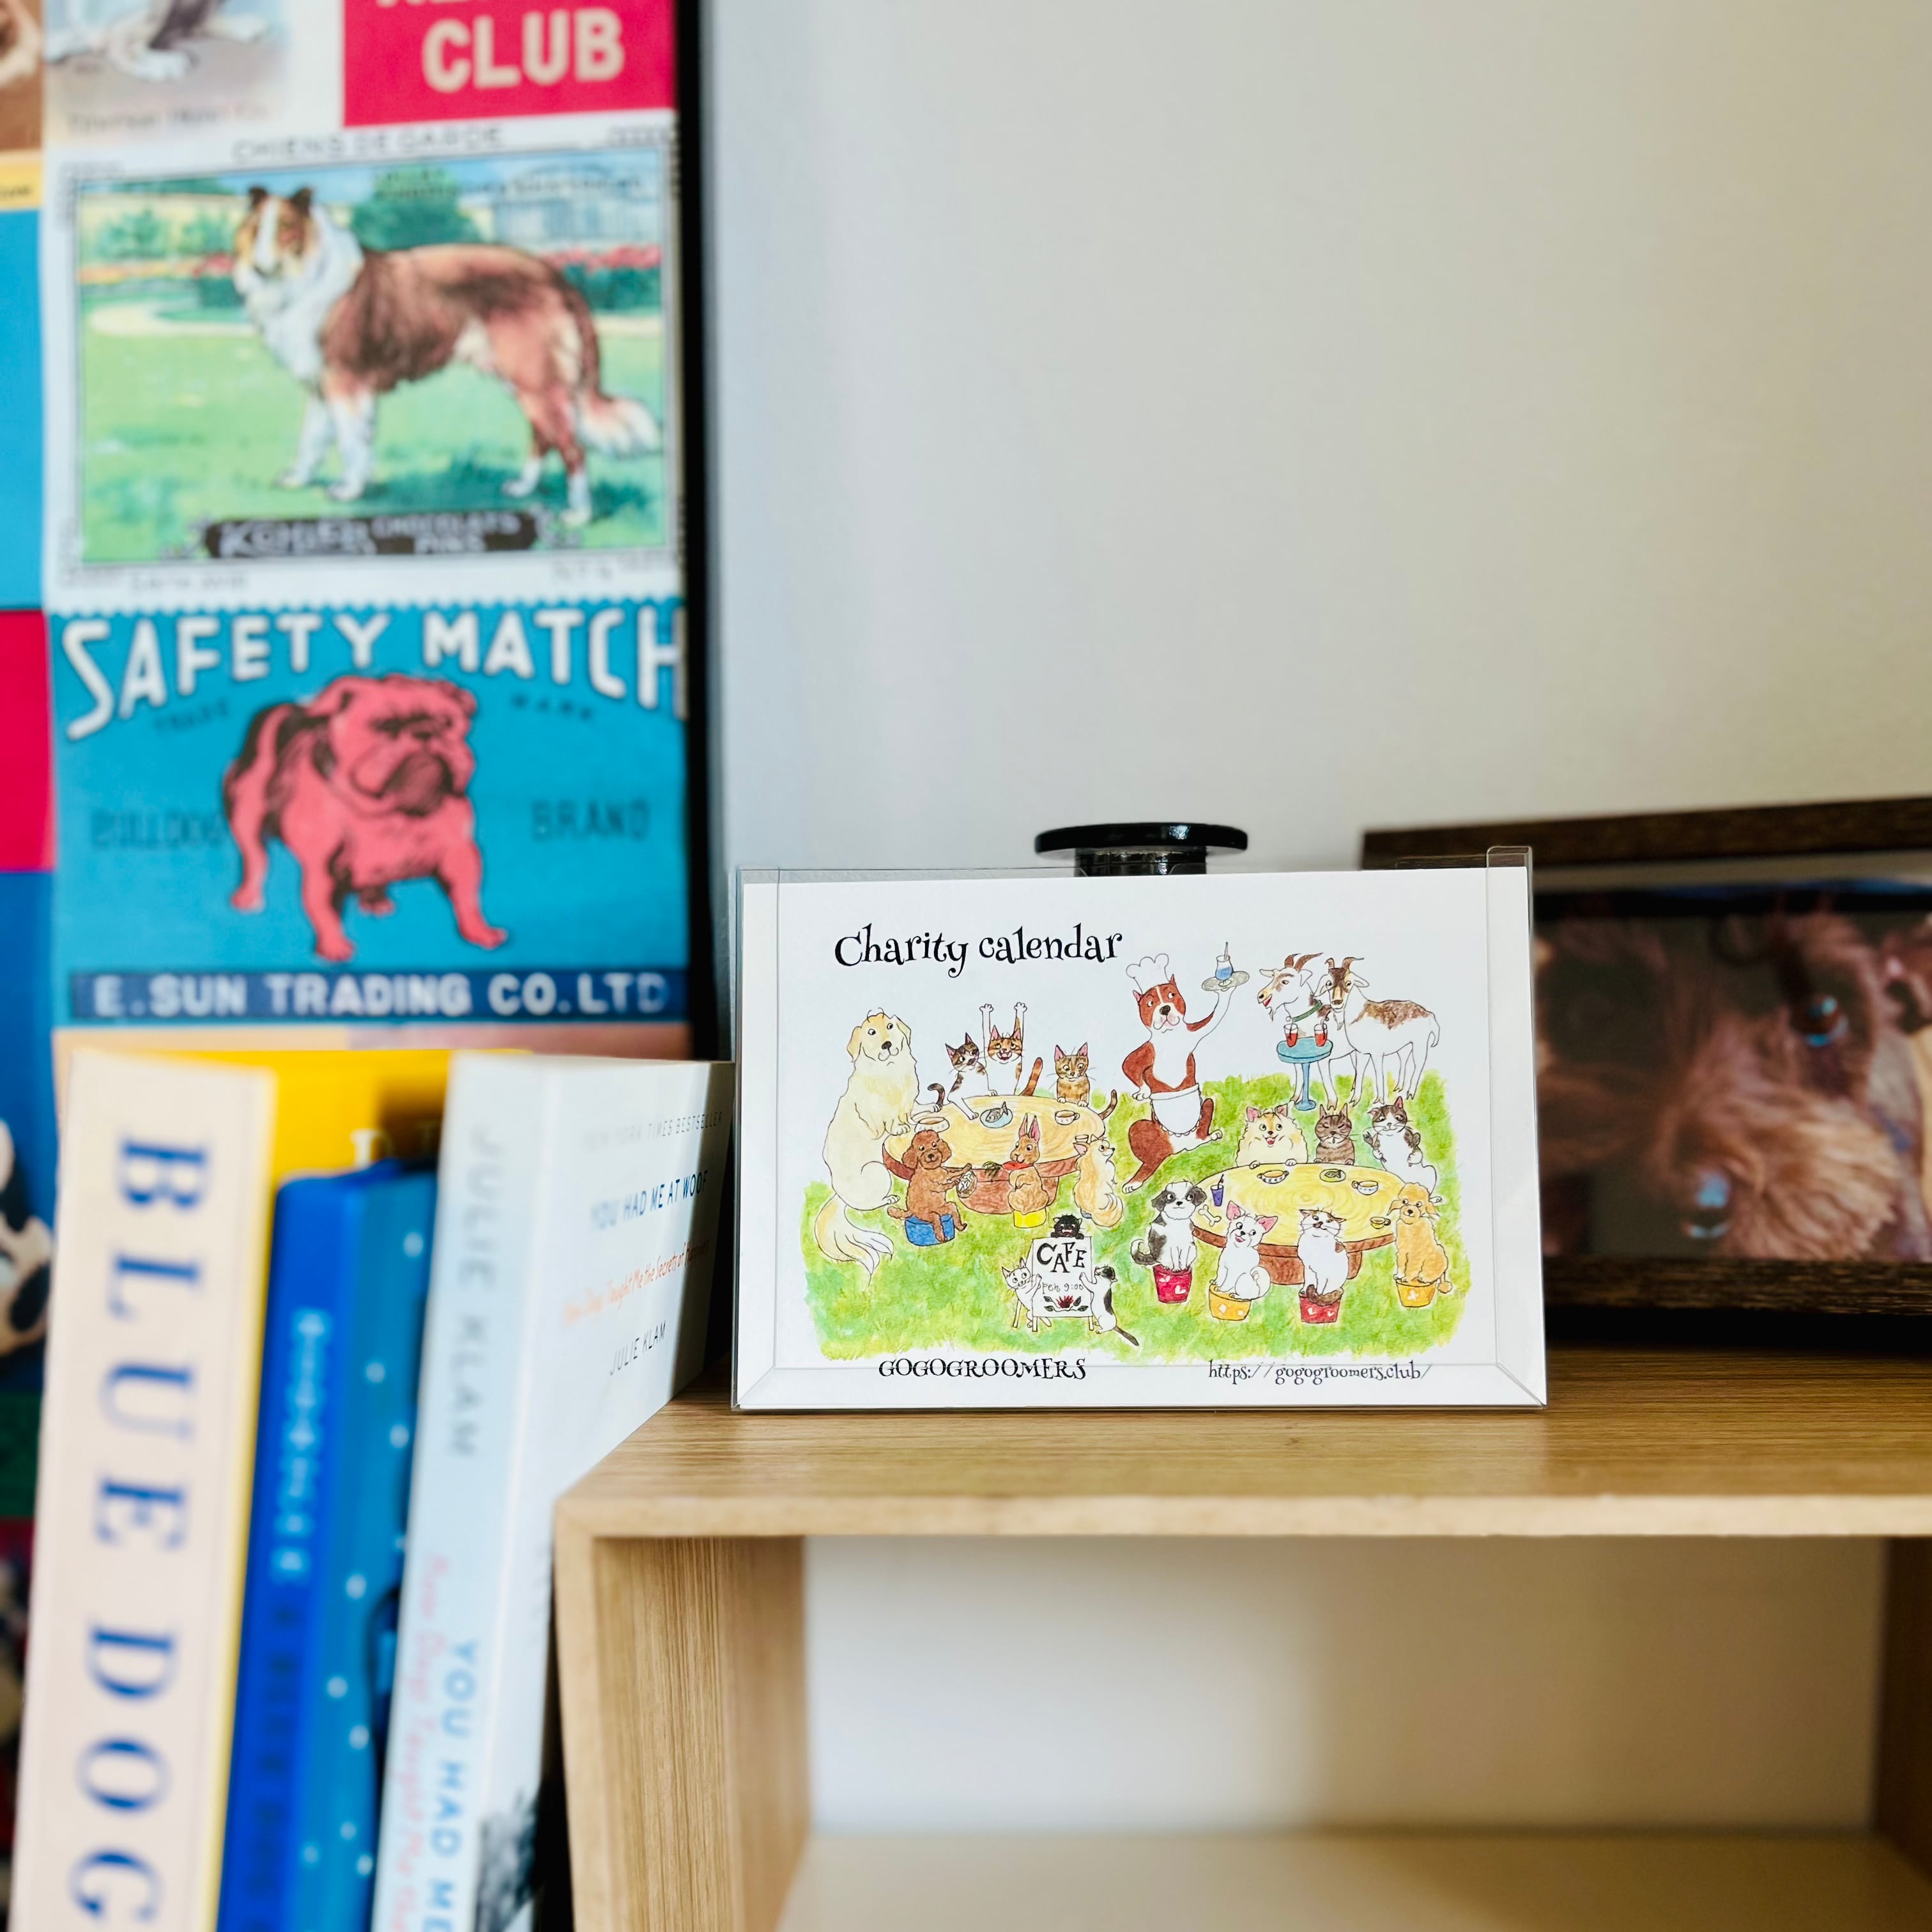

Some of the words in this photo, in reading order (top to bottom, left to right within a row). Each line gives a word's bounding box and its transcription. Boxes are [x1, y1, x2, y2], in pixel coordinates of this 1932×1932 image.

[421, 7, 625, 93] CLUB
[62, 613, 391, 740] SAFETY
[422, 606, 687, 721] MATCH
[834, 922, 969, 978] Charity
[979, 922, 1123, 964] calendar
[263, 972, 472, 1017] TRADING
[647, 1119, 673, 1140] TIMES
[623, 1190, 647, 1222] HAD
[650, 1183, 665, 1212] ME
[667, 1178, 680, 1206] AT
[682, 1170, 709, 1199] WOOF
[1036, 1241, 1087, 1273] CAFE
[93, 1132, 210, 1552] BLUE
[609, 1337, 640, 1376] JULIE
[642, 1320, 666, 1354] KLAM
[878, 1358, 1086, 1380] GOGOGROOMERS
[441, 1637, 480, 1738] YOU
[65, 1616, 180, 1927] DOG
[430, 1759, 468, 1858] HAD
